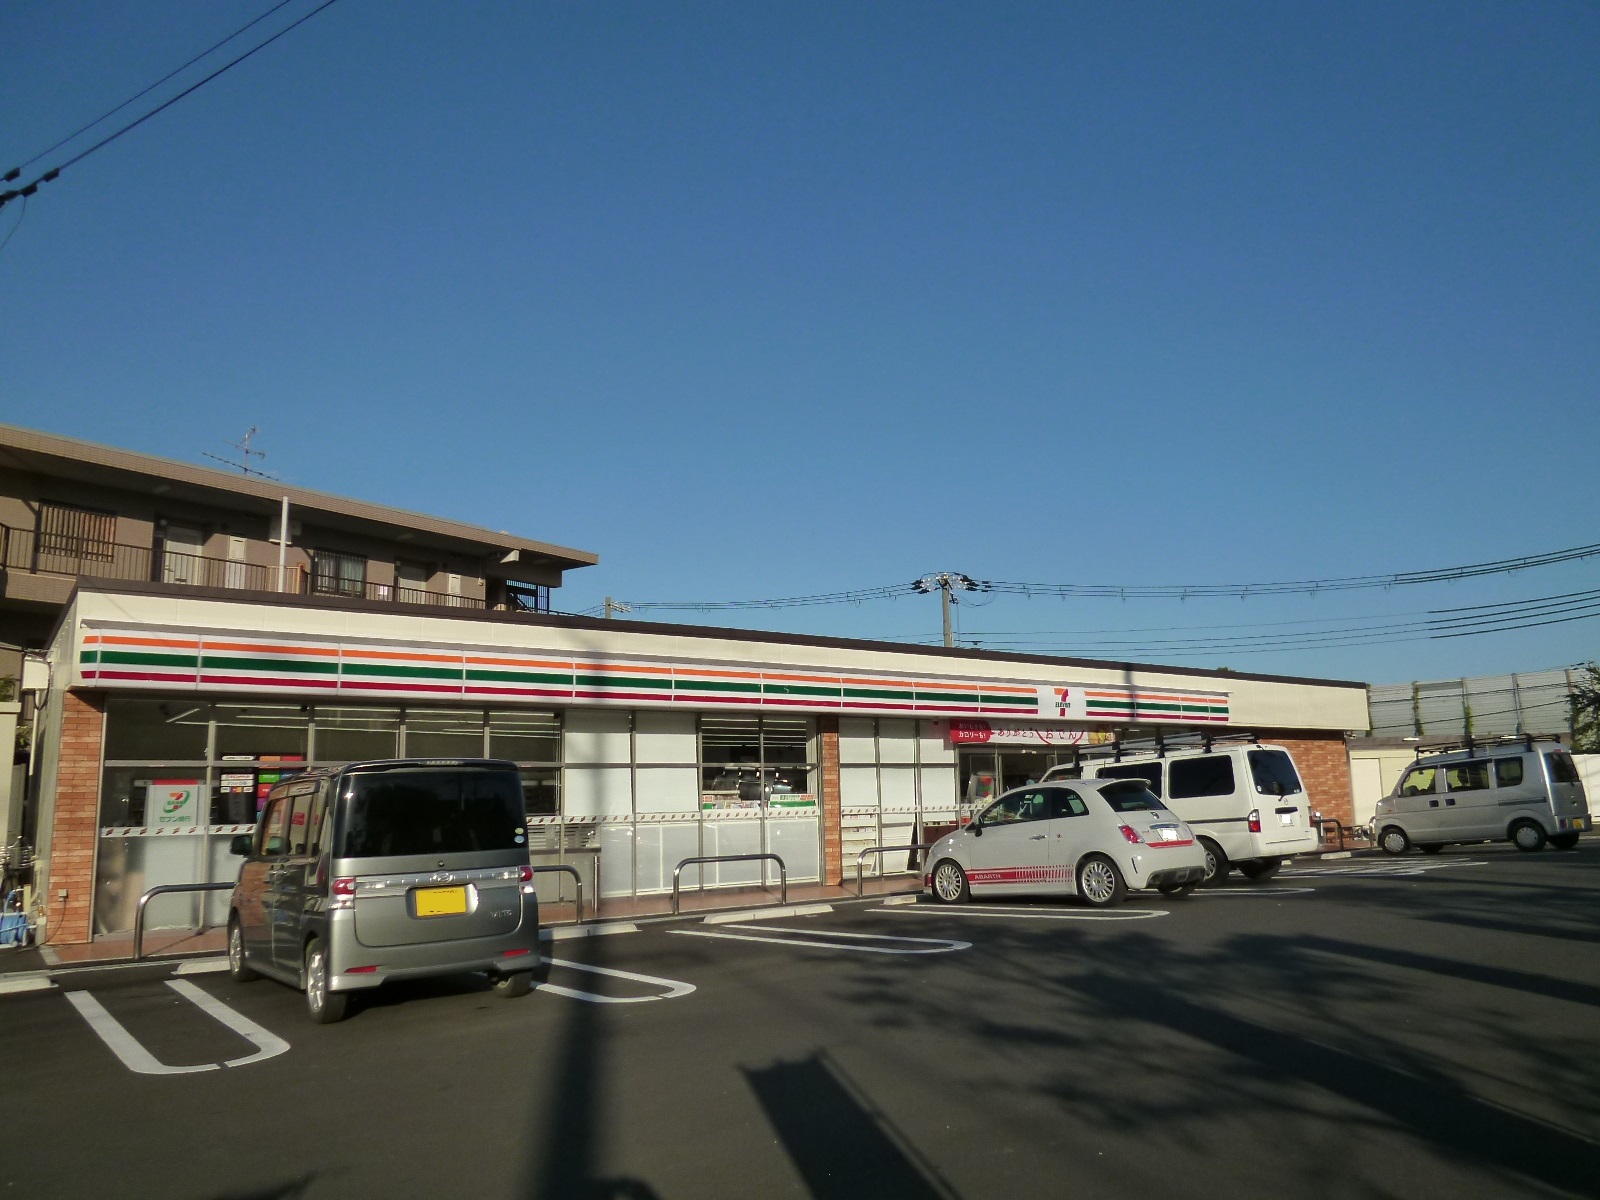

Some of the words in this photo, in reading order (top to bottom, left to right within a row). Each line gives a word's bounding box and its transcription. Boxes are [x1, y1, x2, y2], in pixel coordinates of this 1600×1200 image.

[1053, 688, 1069, 717] 7
[997, 727, 1034, 738] ありがとう
[1045, 727, 1077, 739] おでん
